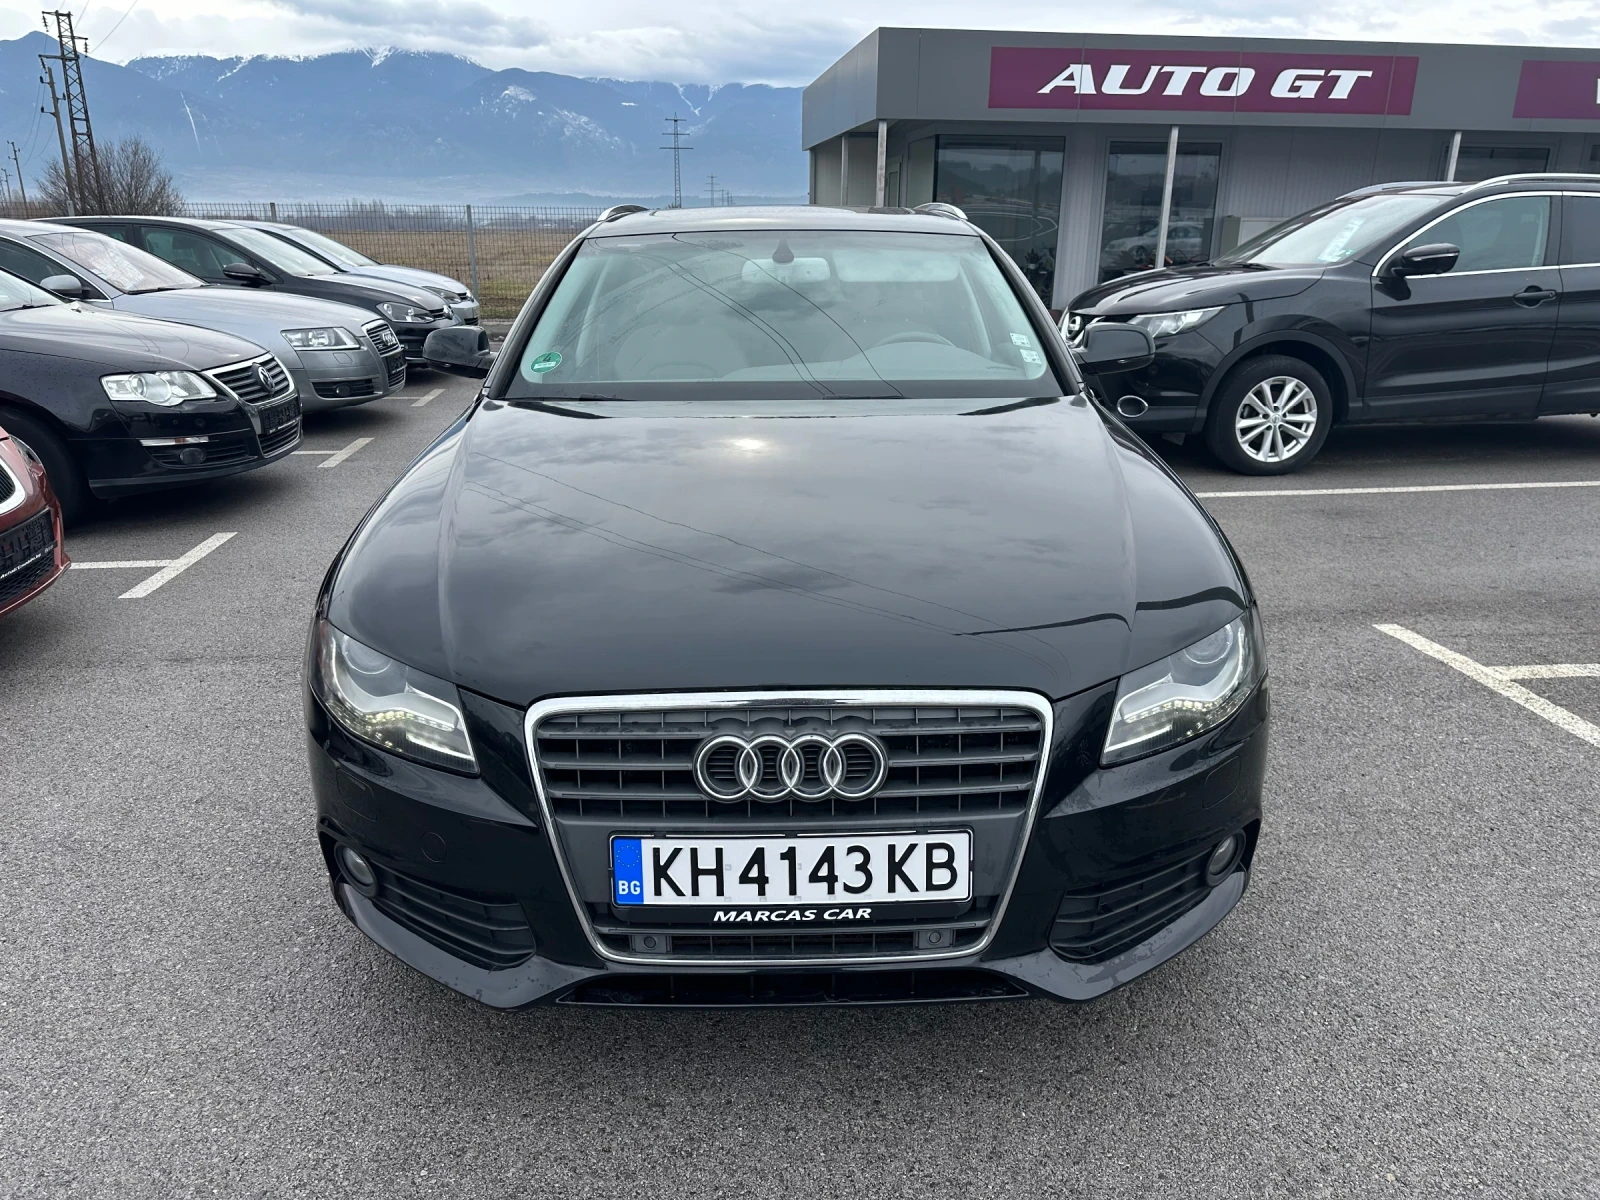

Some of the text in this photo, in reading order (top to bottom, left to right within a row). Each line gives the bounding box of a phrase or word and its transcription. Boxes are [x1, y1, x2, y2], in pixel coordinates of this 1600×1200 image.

[1036, 63, 1373, 100] AUTO GT
[618, 880, 641, 895] BG
[713, 908, 872, 922] MARCAS CAR
